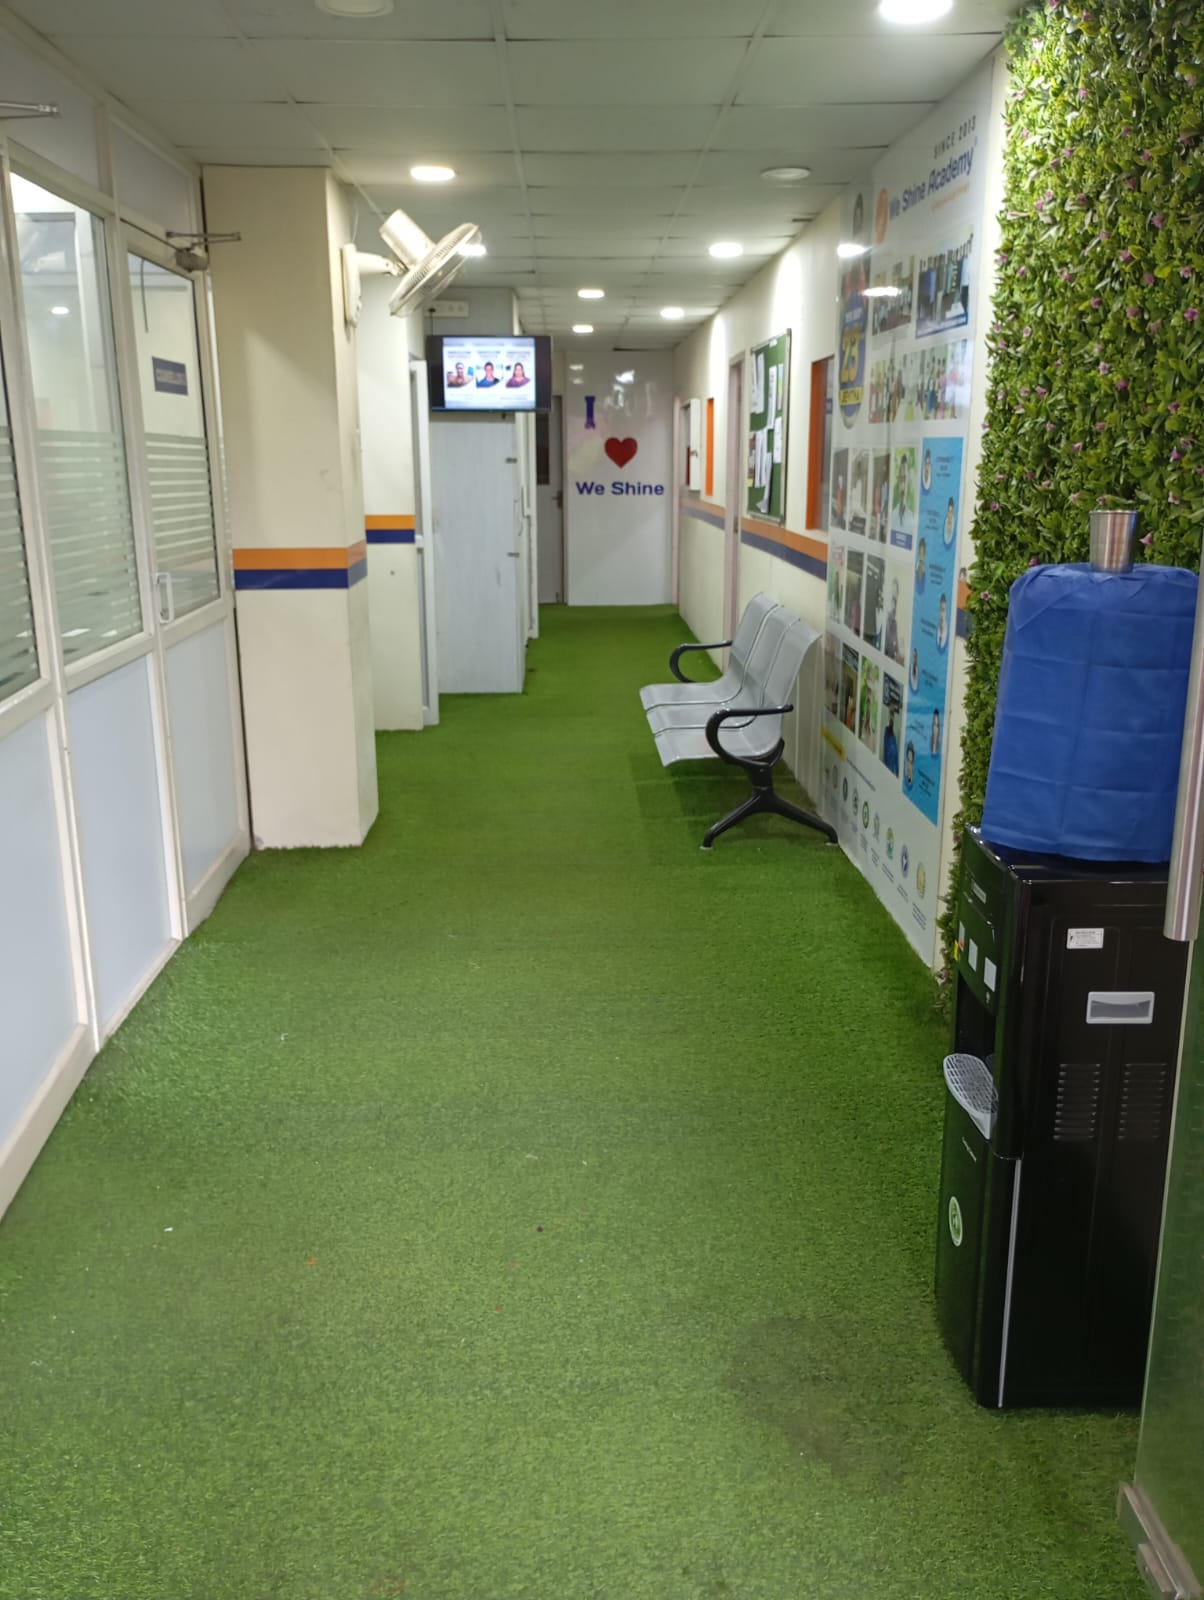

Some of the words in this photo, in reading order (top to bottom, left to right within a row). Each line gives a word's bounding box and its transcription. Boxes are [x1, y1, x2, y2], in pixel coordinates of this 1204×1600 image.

[933, 131, 956, 159] SINCE
[902, 182, 925, 211] Shine
[928, 147, 974, 196] Academy
[584, 395, 596, 429] I
[576, 481, 605, 496] We
[611, 481, 665, 496] Shine
